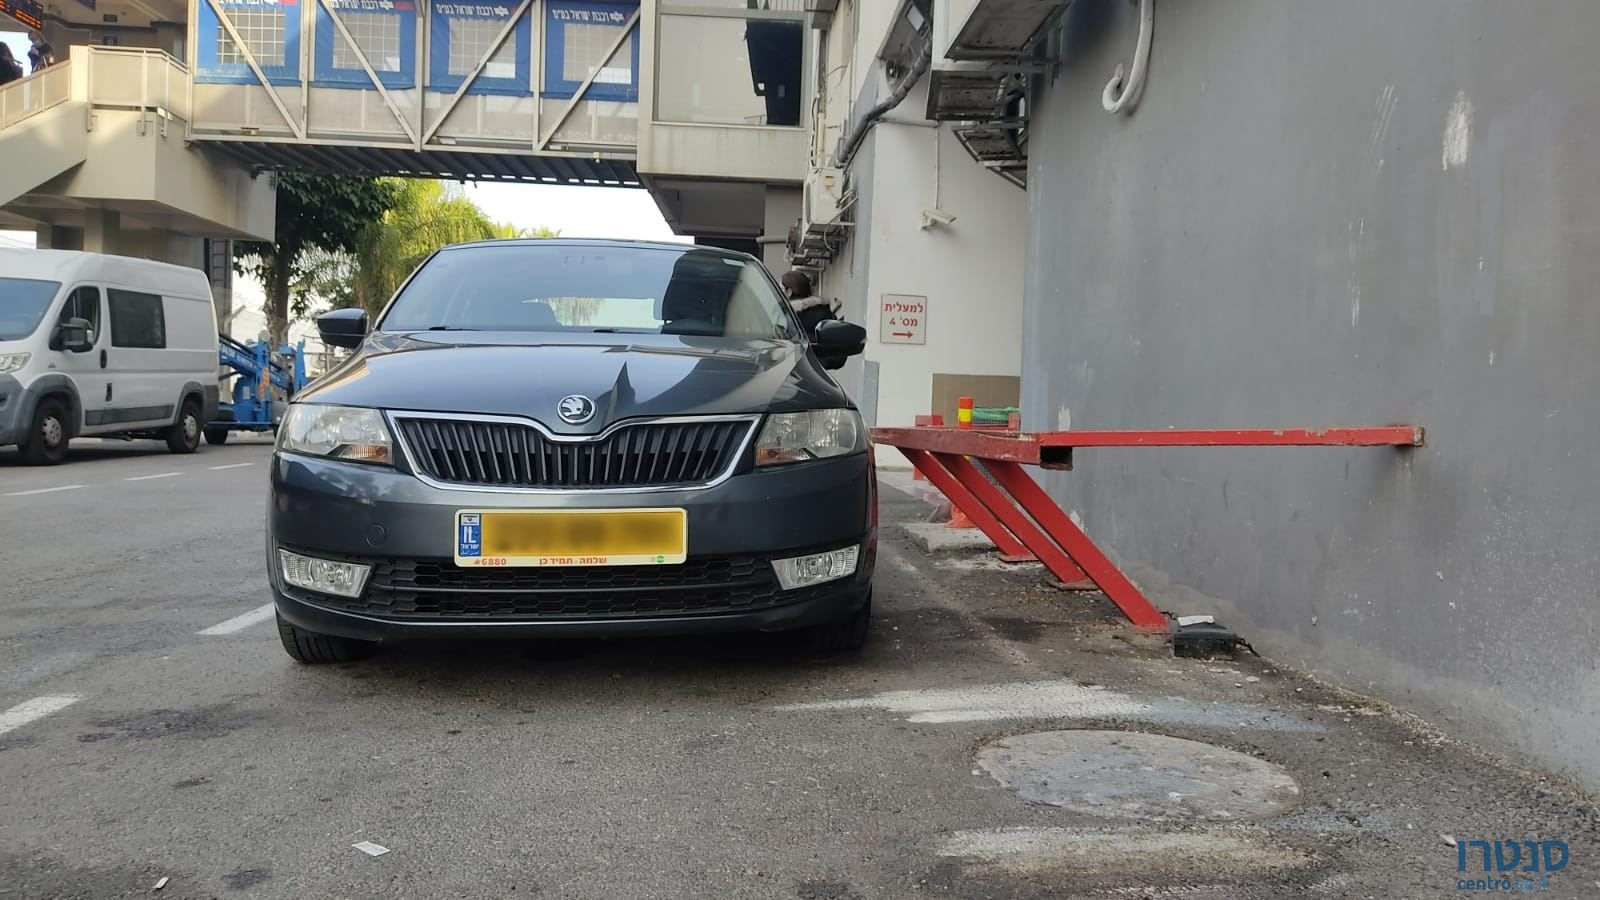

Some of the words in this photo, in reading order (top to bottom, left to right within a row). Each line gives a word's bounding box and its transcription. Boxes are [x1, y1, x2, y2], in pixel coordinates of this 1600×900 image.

[453, 4, 474, 15] ישראל
[476, 6, 495, 16] רכבת
[570, 9, 591, 21] ישראל
[591, 11, 610, 21] רכבת
[885, 302, 923, 313] למעלית
[889, 317, 896, 325] 4
[463, 525, 477, 544] IL
[539, 557, 548, 565] כן
[550, 557, 574, 565] תמיד
[579, 556, 608, 565] שלמה
